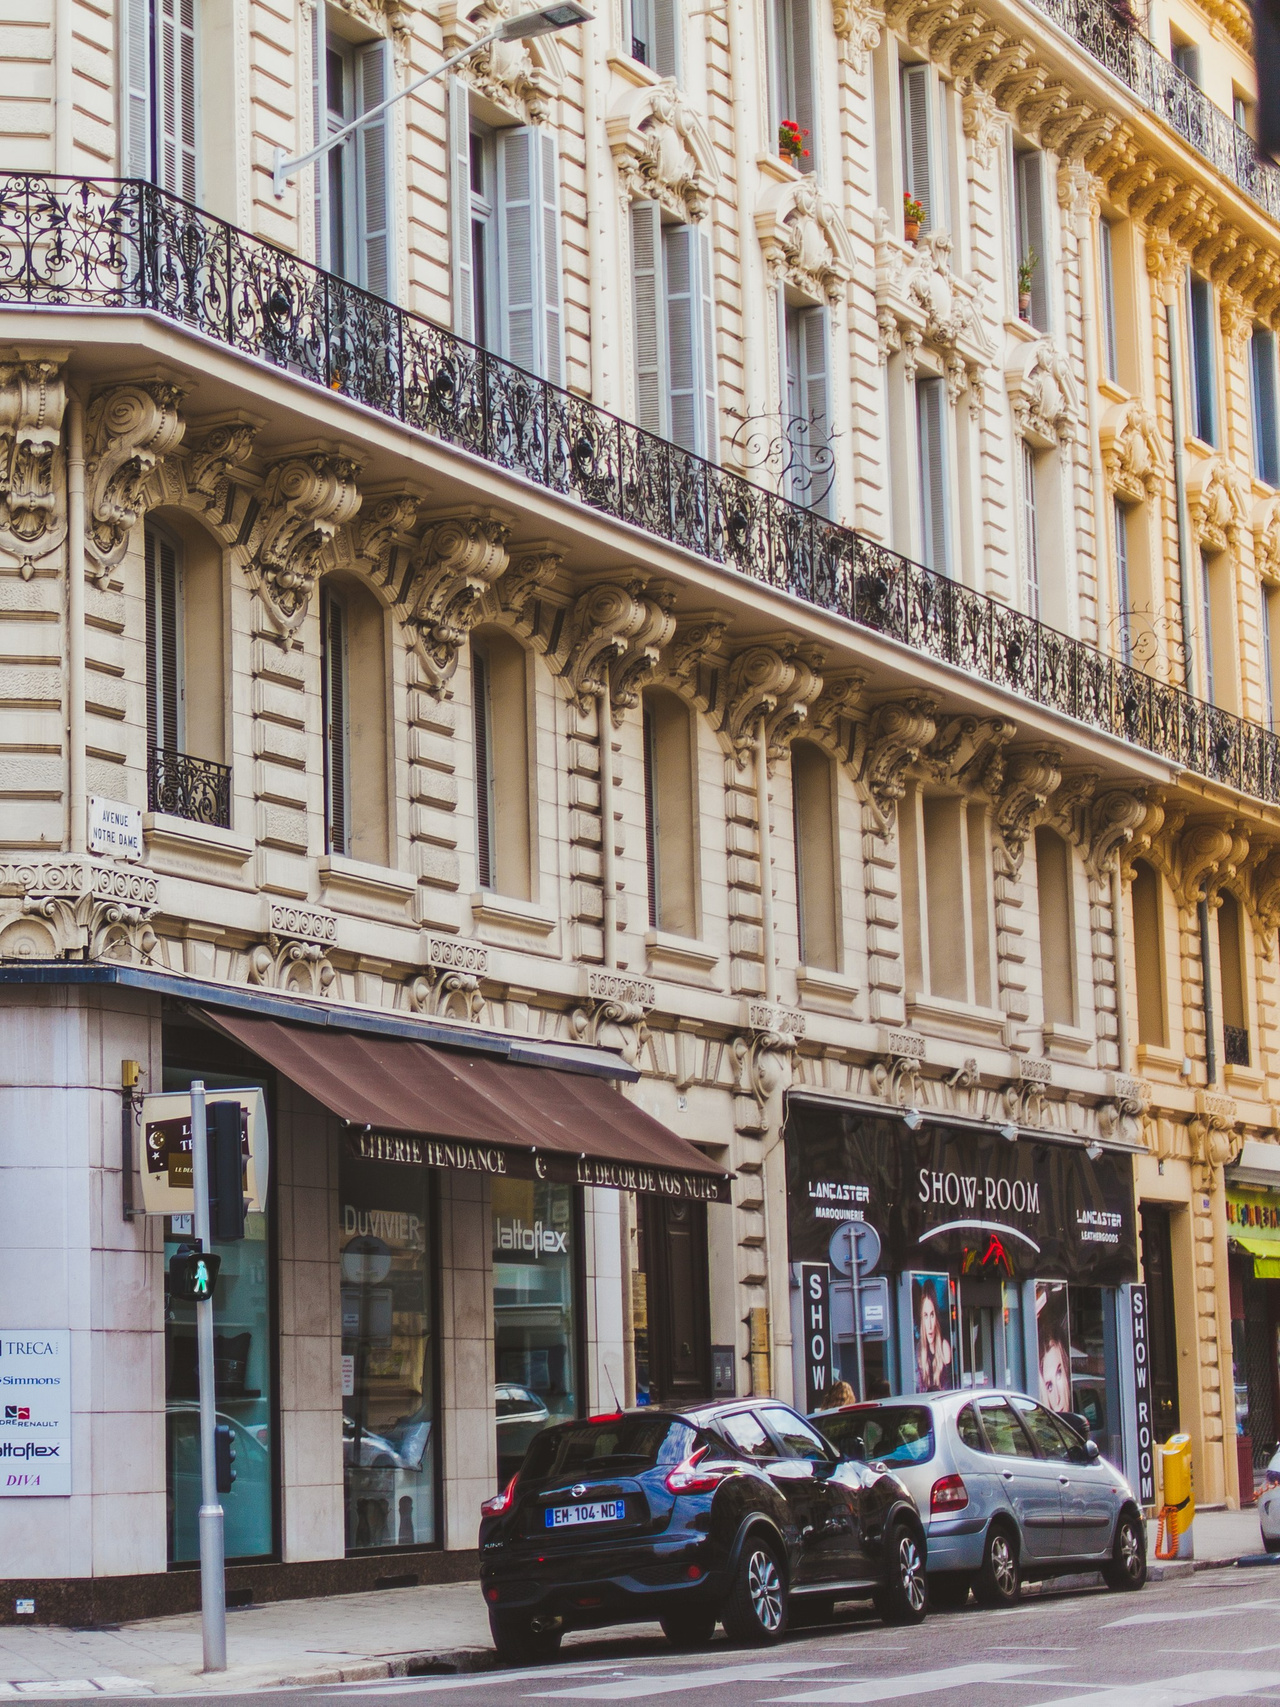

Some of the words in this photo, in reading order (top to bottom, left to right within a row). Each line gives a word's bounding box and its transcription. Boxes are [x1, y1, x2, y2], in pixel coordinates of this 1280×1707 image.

[102, 810, 128, 827] AVENUE
[93, 827, 115, 843] NOTRE
[119, 834, 138, 848] DAME
[360, 1134, 422, 1164] LITERIE
[425, 1140, 507, 1174] TENDANCE
[577, 1159, 593, 1183] LE
[595, 1162, 637, 1189] DECOR
[639, 1168, 656, 1191] DE
[658, 1171, 681, 1195] VOS
[684, 1176, 718, 1199] NUITS
[808, 1181, 870, 1203] LANCASTER
[919, 1168, 1040, 1214] SHOW-ROOM
[344, 1205, 420, 1241] DUVIVIER
[815, 1207, 865, 1221] MAROQUINERIE
[1077, 1209, 1122, 1228] LANCASTER
[497, 1217, 567, 1259] lattoflex
[1081, 1230, 1119, 1244] LEATHERGOODS
[809, 1273, 825, 1391] SHOW
[1133, 1293, 1147, 1388] SHOW
[6, 1342, 54, 1355] TRECA
[3, 1376, 61, 1385] Simmons
[1138, 1402, 1152, 1498] ROOM
[6, 1475, 41, 1486] DIVA
